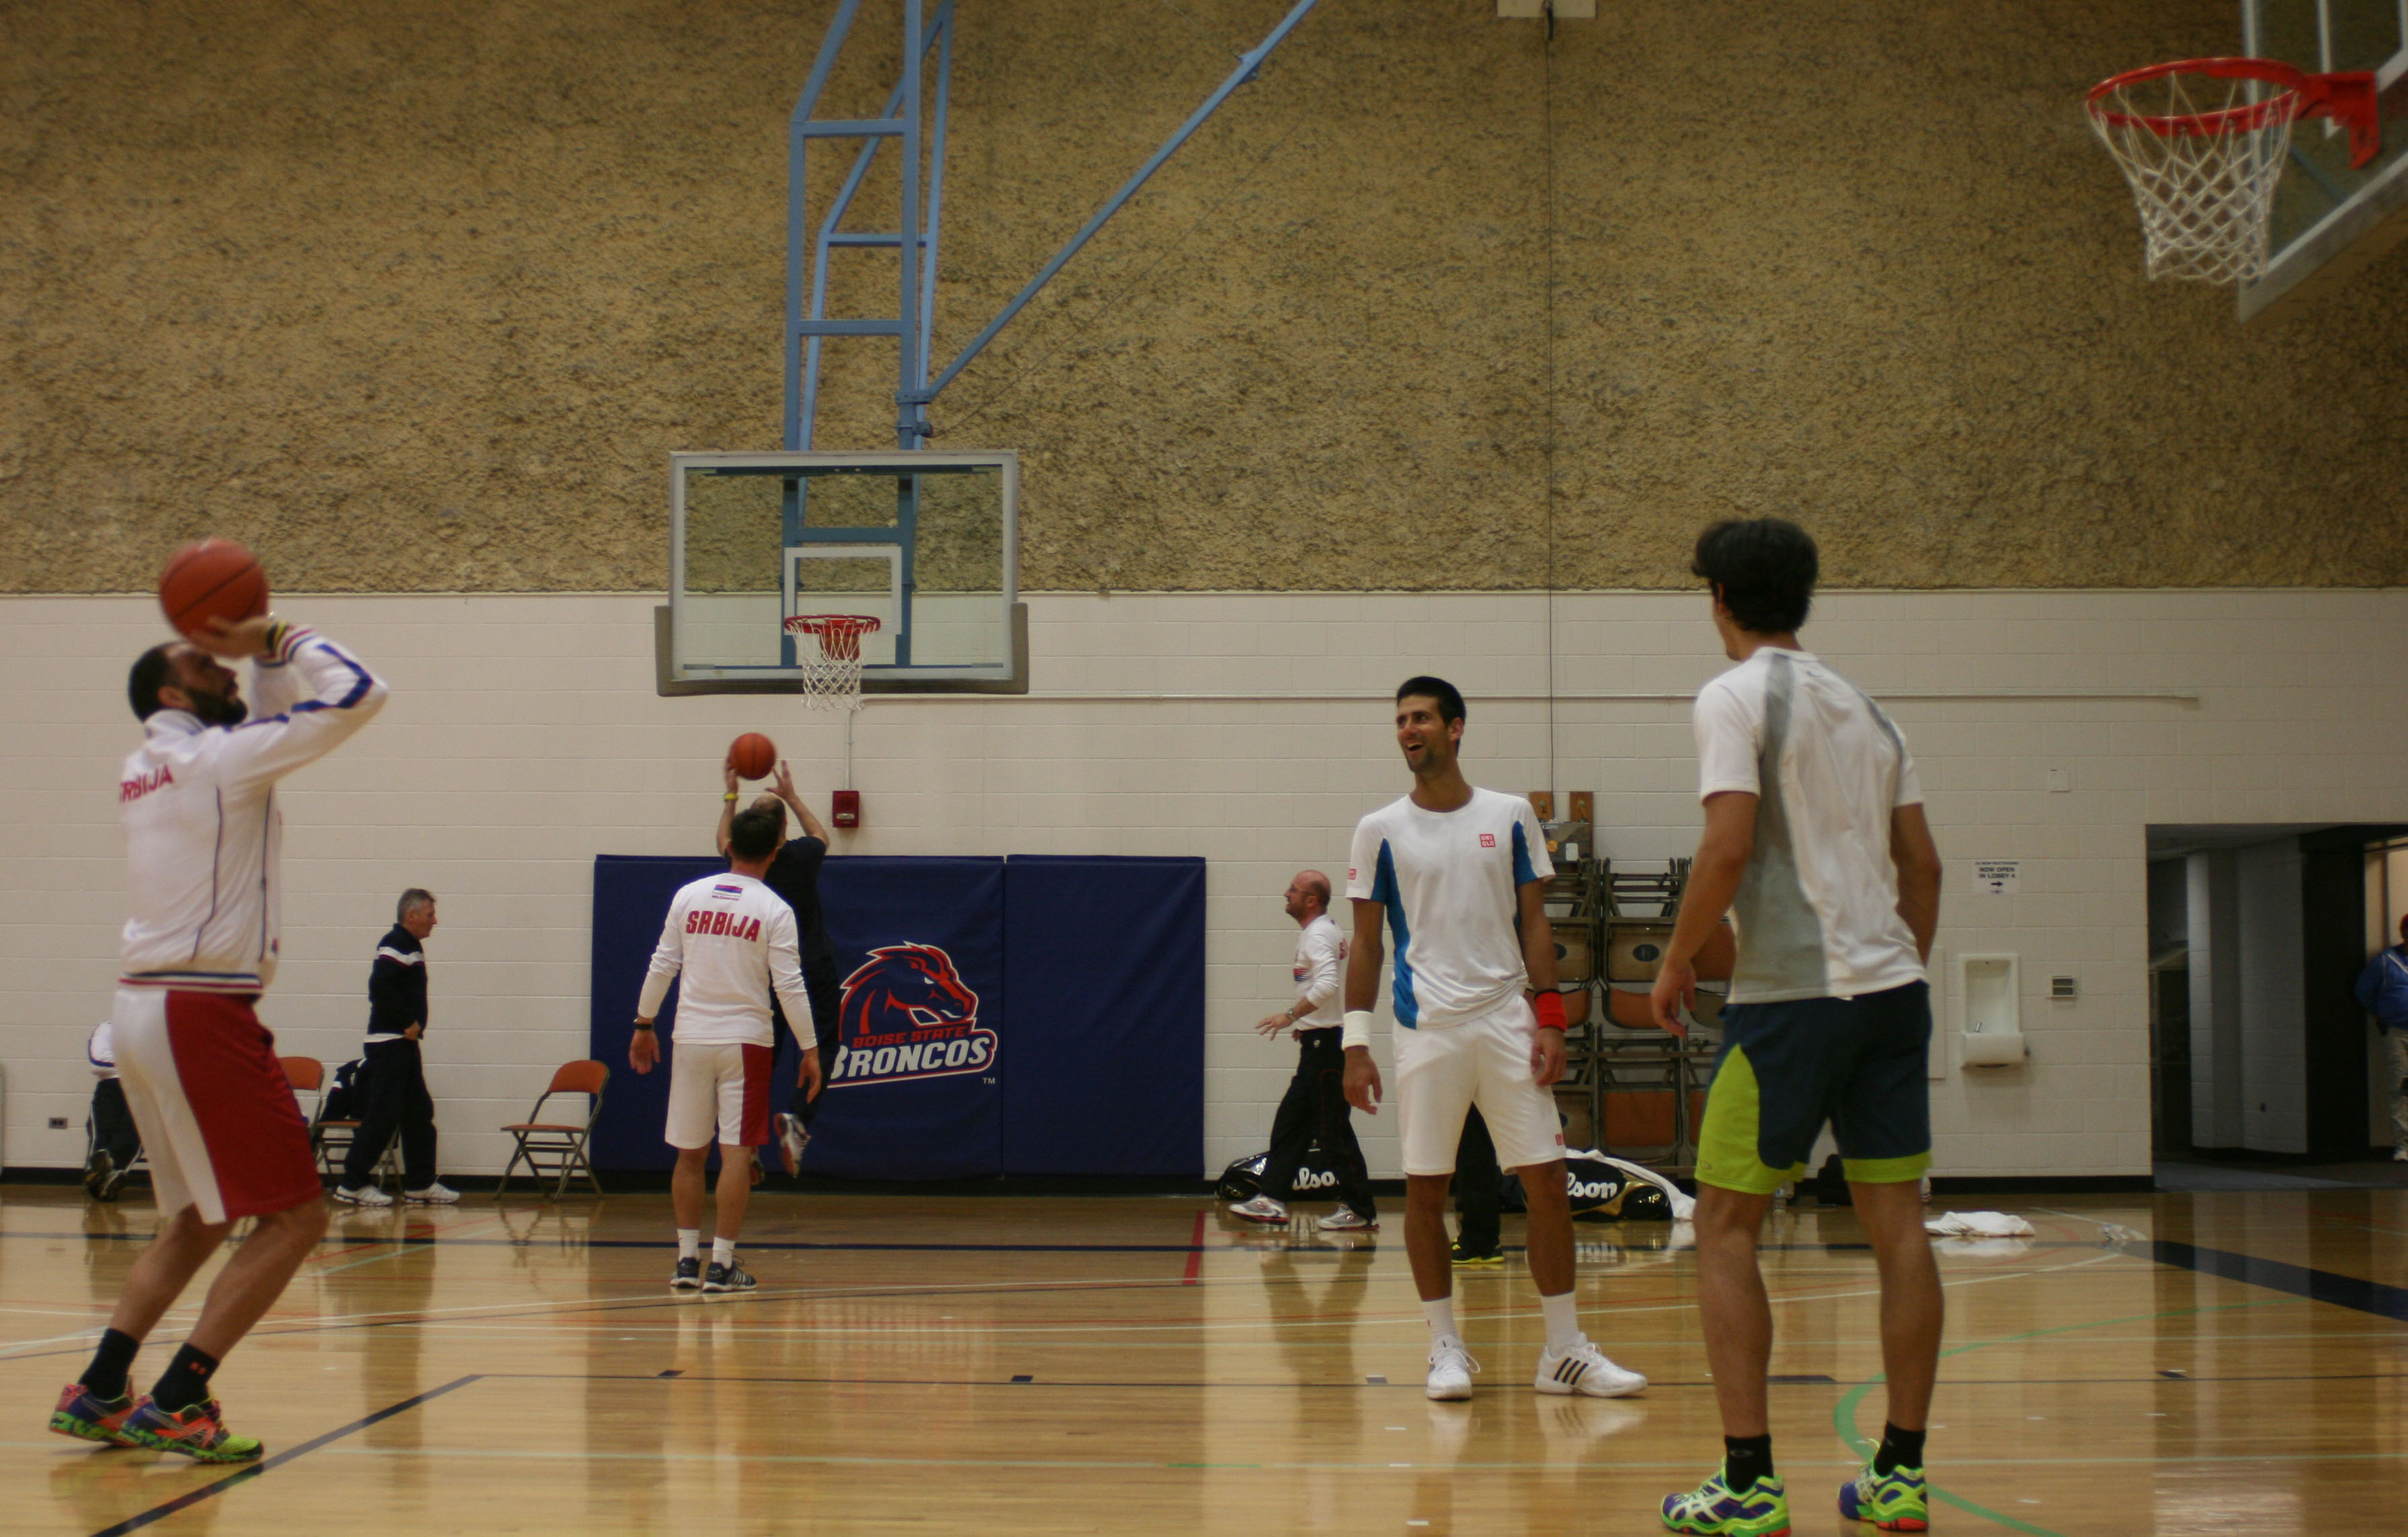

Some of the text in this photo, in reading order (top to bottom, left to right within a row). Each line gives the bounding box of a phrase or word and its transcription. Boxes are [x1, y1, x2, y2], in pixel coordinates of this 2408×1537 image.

[119, 764, 174, 803] RBIJA
[686, 910, 761, 942] SRBIJA
[852, 1026, 968, 1049] BOISE STATE
[830, 1037, 990, 1080] BRONCOS
[1567, 1172, 1617, 1199] lson
